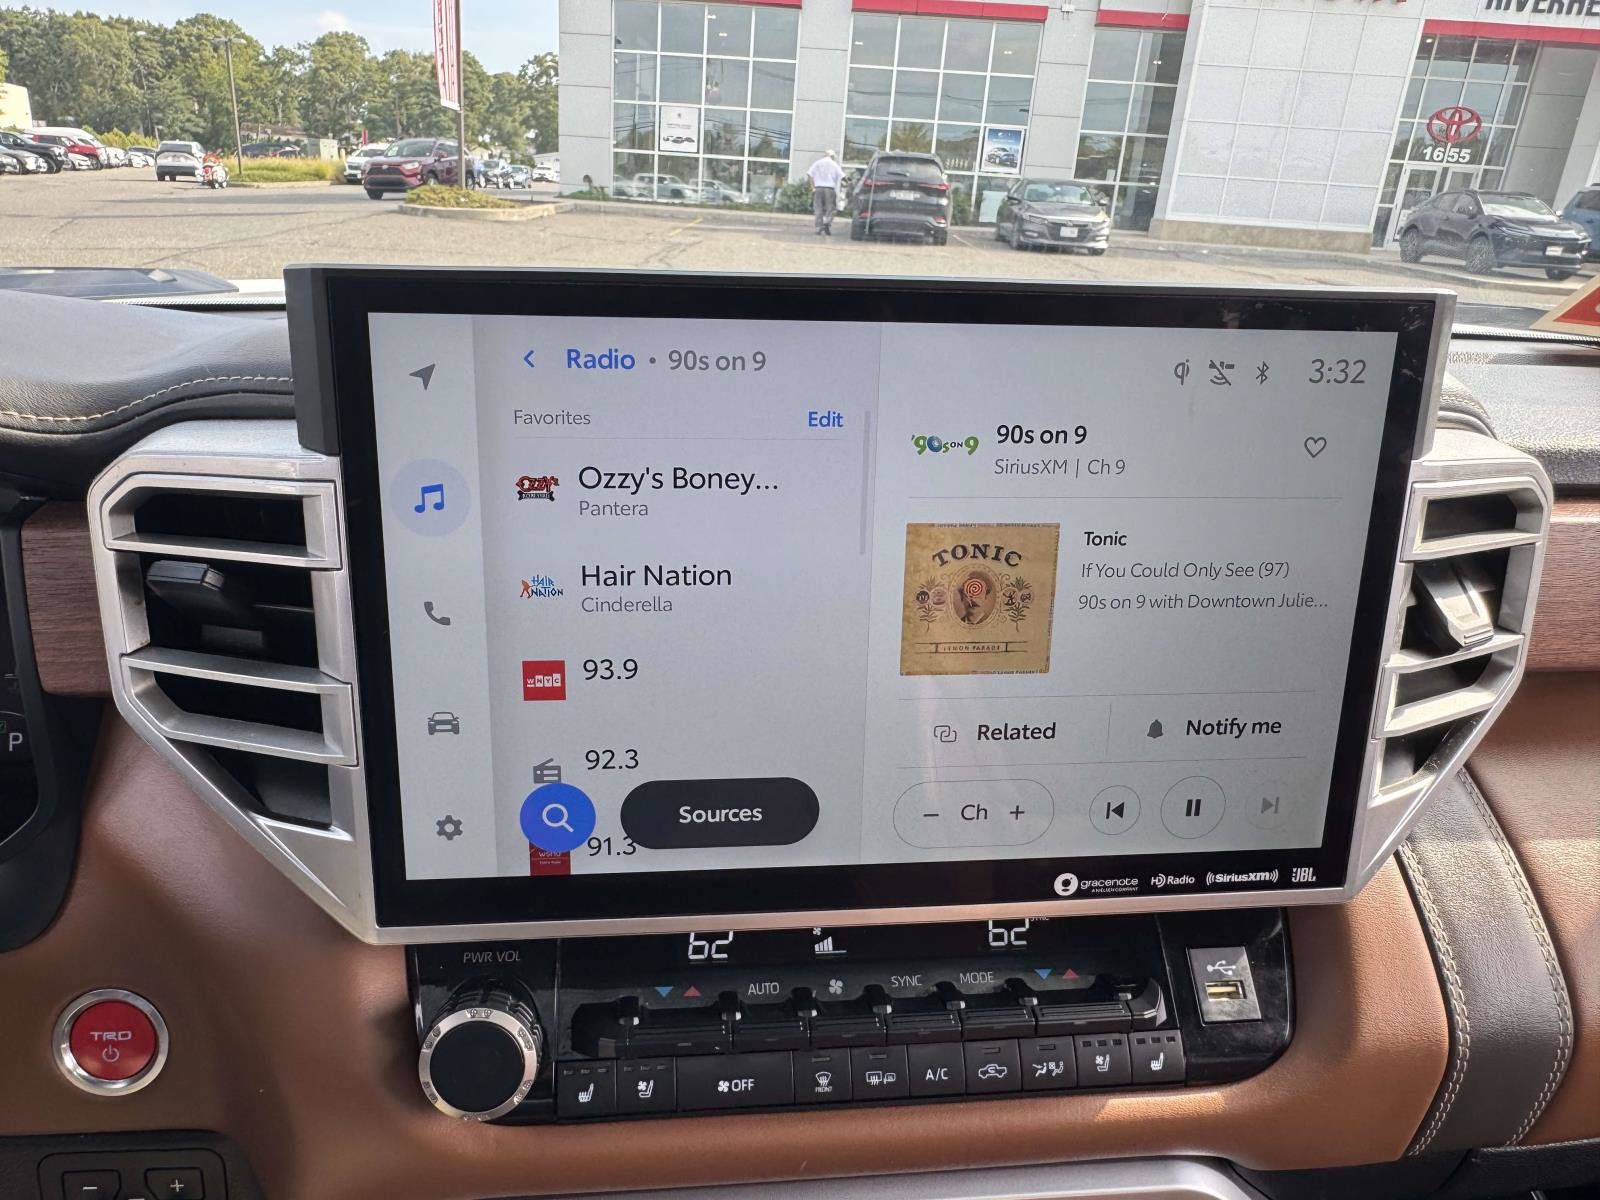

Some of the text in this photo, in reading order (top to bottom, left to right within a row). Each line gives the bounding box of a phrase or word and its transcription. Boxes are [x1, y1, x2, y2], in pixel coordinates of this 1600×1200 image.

[1423, 146, 1472, 163] 1655
[566, 348, 767, 372] Radio 90s on 9
[1308, 358, 1367, 385] 3:32
[513, 409, 591, 426] Favorites
[807, 411, 844, 429] Edit
[996, 424, 1088, 445] 90s on 9
[994, 458, 1126, 475] SiriusXM Ch 9
[578, 466, 779, 495] Ozzy's Boney...
[578, 500, 649, 517] Pantera
[1084, 531, 1128, 547] Tonic
[932, 543, 1022, 568] TONIC
[581, 565, 732, 587] Hair Nation
[1081, 561, 1291, 580] If You Could Only See (97)
[581, 596, 673, 613] Cinderella
[1078, 594, 1107, 609] 90s
[1110, 597, 1131, 609] on
[1136, 594, 1146, 609] 9
[1149, 594, 1184, 609] with
[1187, 593, 1276, 609] Downtown
[582, 659, 639, 680] 93.9
[976, 722, 1056, 741] Related
[1185, 718, 1282, 740] Notify me
[8, 732, 23, 751] P
[584, 749, 640, 770] 92.3
[678, 804, 763, 824] Sources
[960, 804, 988, 822] Ch
[587, 836, 637, 857] 91.3
[1167, 875, 1195, 885] Radio
[1292, 867, 1317, 882] JBL
[1080, 877, 1139, 890] gracenote
[463, 950, 521, 963] PWR VOL
[890, 974, 922, 987] SYNC
[959, 970, 994, 985] MODE
[747, 982, 780, 996] AUTO
[90, 1030, 132, 1041] TRD
[925, 1068, 949, 1081] A/C
[731, 1078, 755, 1092] OFF
